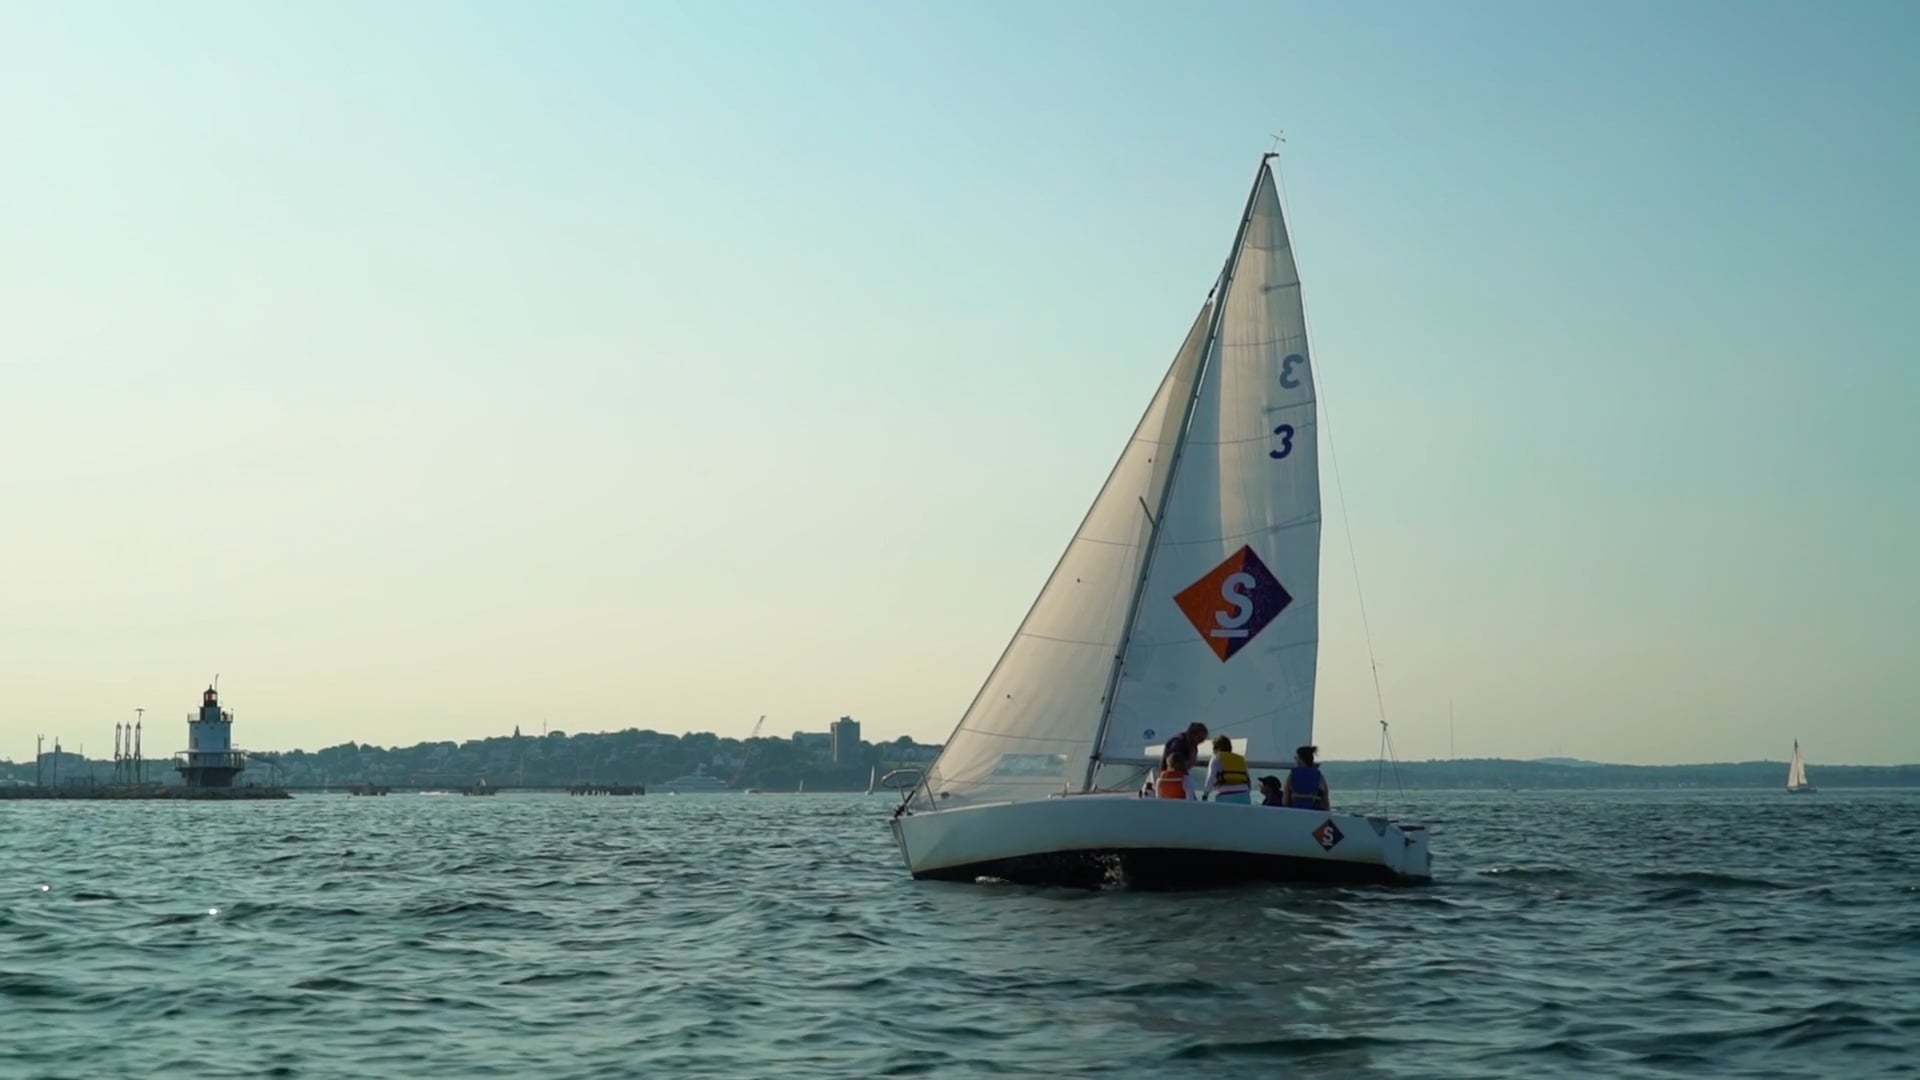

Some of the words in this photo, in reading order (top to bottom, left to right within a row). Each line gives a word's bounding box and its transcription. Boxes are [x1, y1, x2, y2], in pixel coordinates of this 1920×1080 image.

[1268, 423, 1295, 460] 3
[1215, 571, 1256, 629] S
[1322, 825, 1334, 843] S
